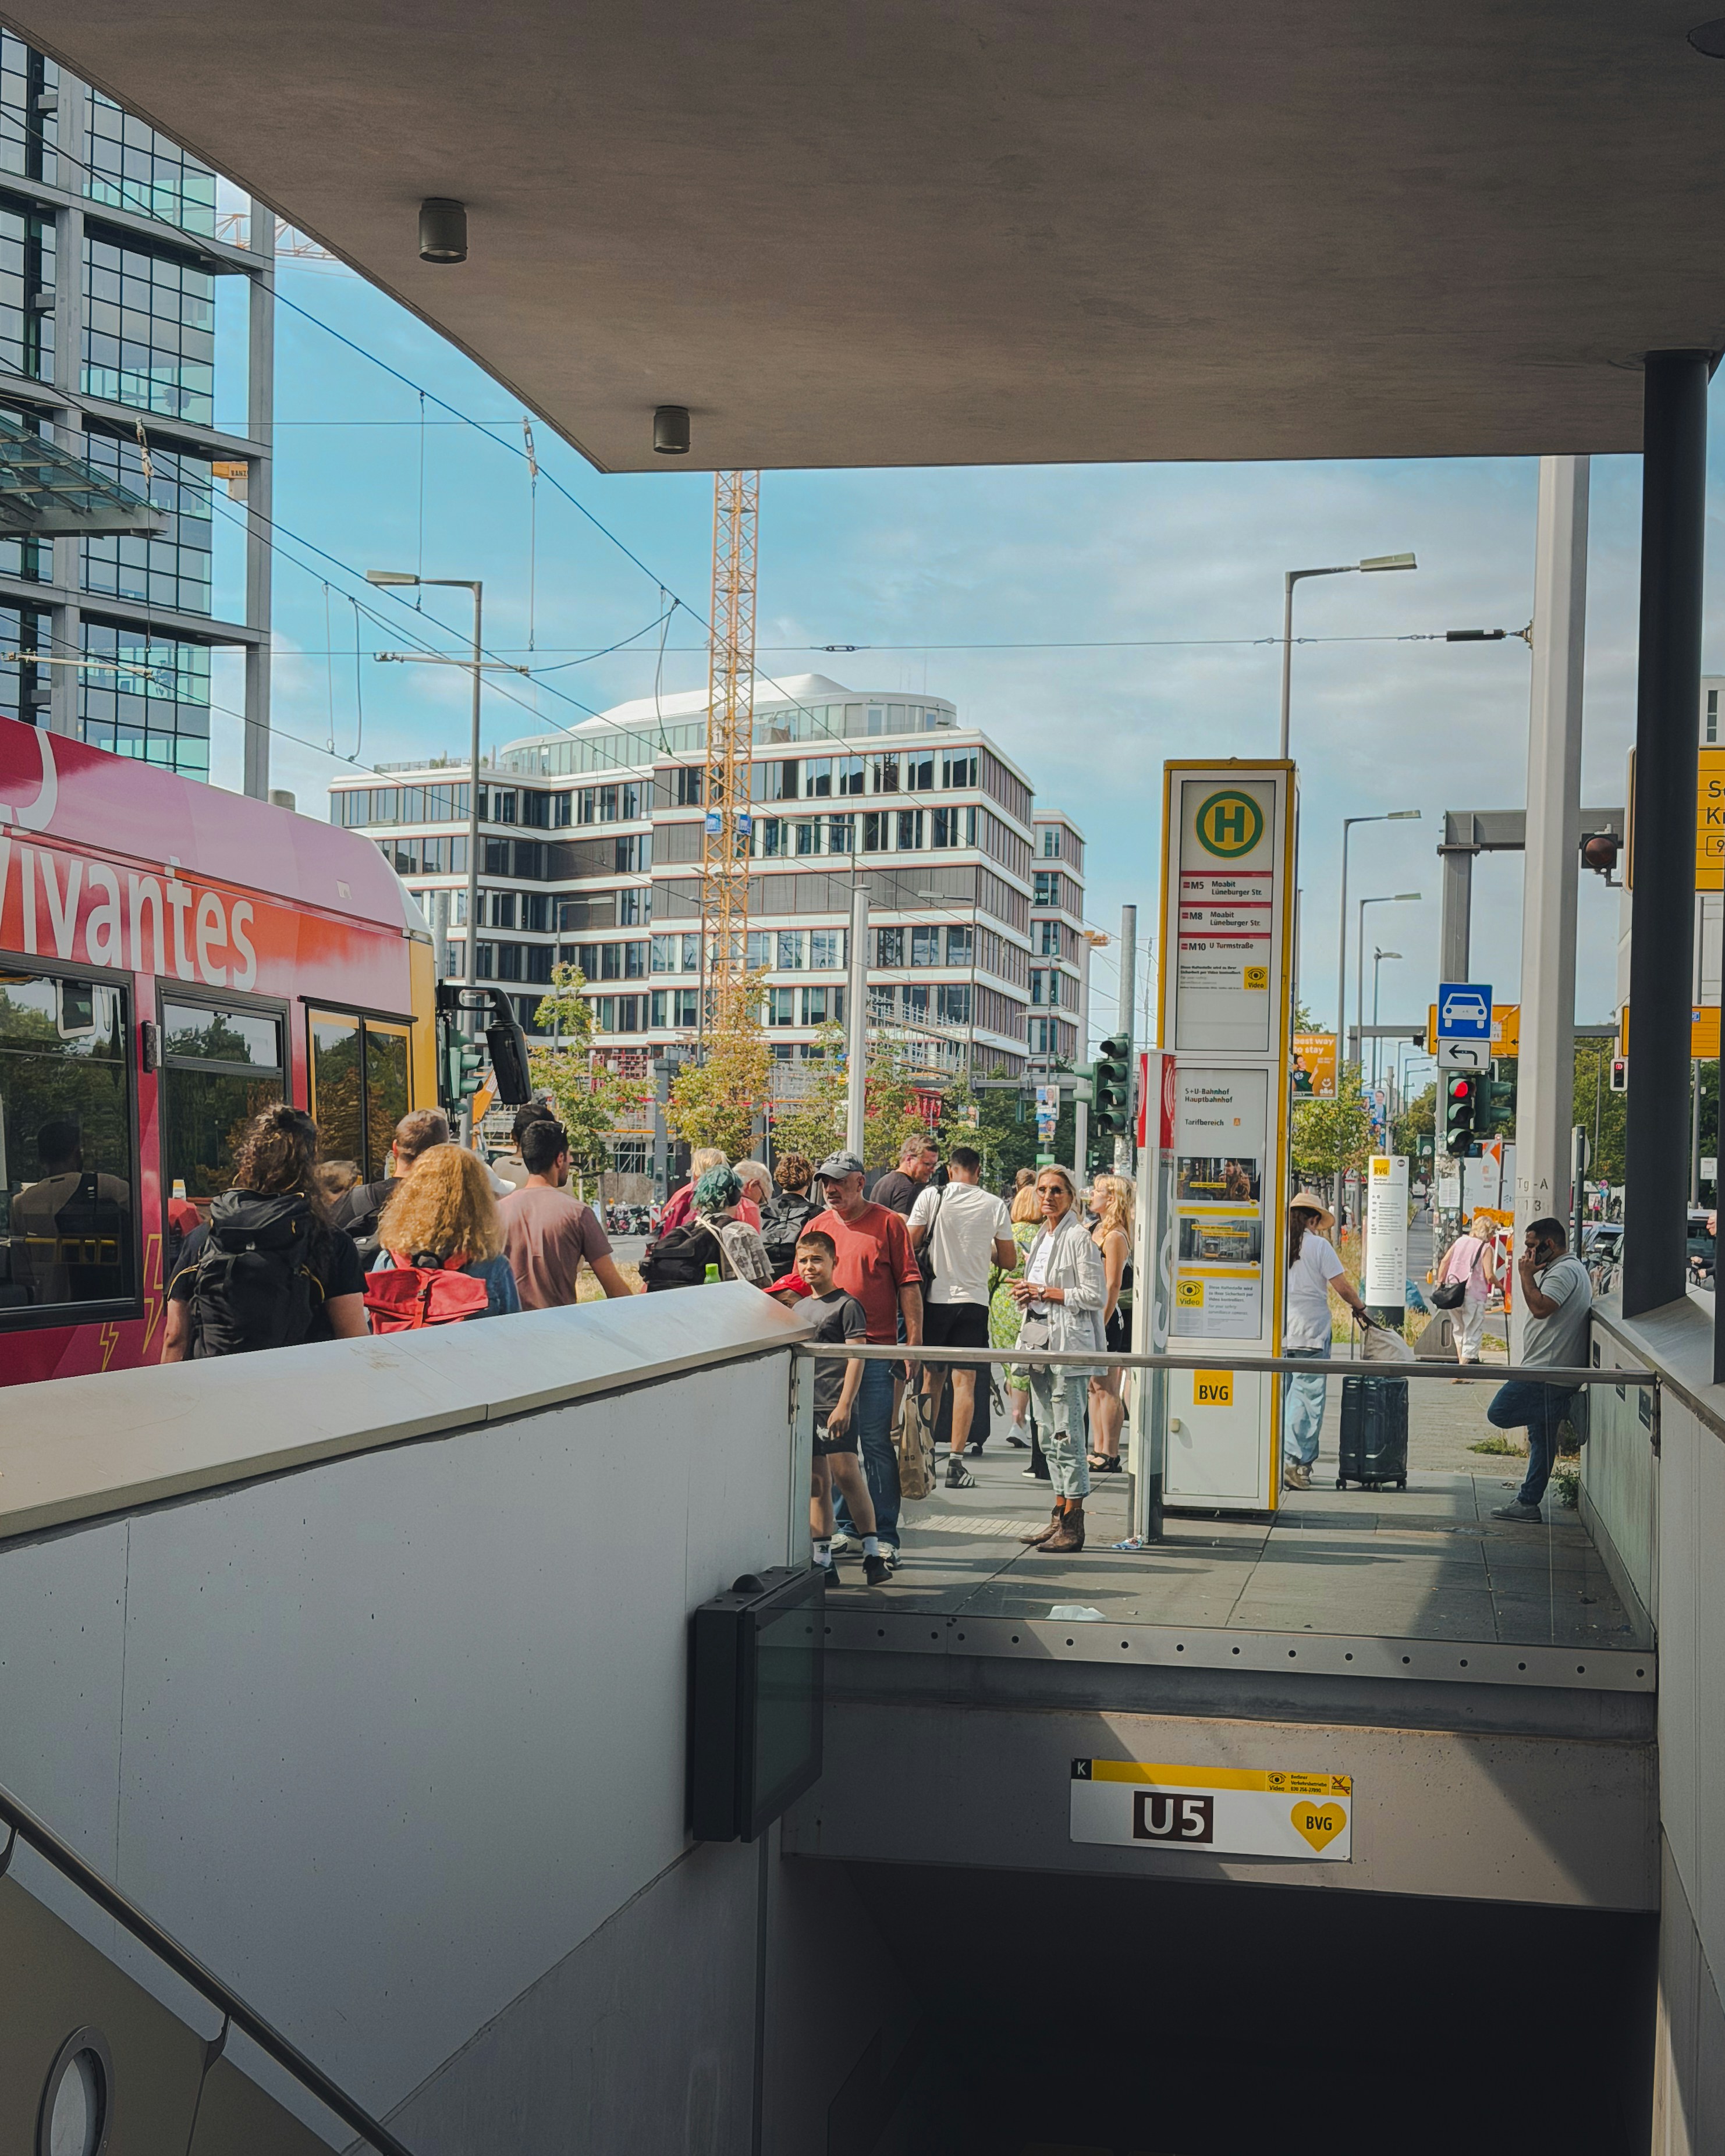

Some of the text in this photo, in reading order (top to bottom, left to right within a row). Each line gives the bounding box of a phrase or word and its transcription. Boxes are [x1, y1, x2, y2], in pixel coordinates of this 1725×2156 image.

[1708, 780, 1725, 798] S
[1707, 807, 1725, 825] K
[1215, 807, 1245, 843] H
[1212, 889, 1250, 897] Lüneburger
[0, 836, 257, 992] ivantes
[1190, 912, 1203, 920] M8
[1211, 919, 1248, 927] Lüneburger
[1188, 943, 1206, 951] M10
[1315, 1038, 1334, 1046] way
[1305, 1046, 1324, 1055] stay
[1199, 1385, 1229, 1401] BVG
[1077, 1761, 1087, 1775] K
[1144, 1797, 1205, 1837] U5
[1306, 1815, 1333, 1831] BVG
